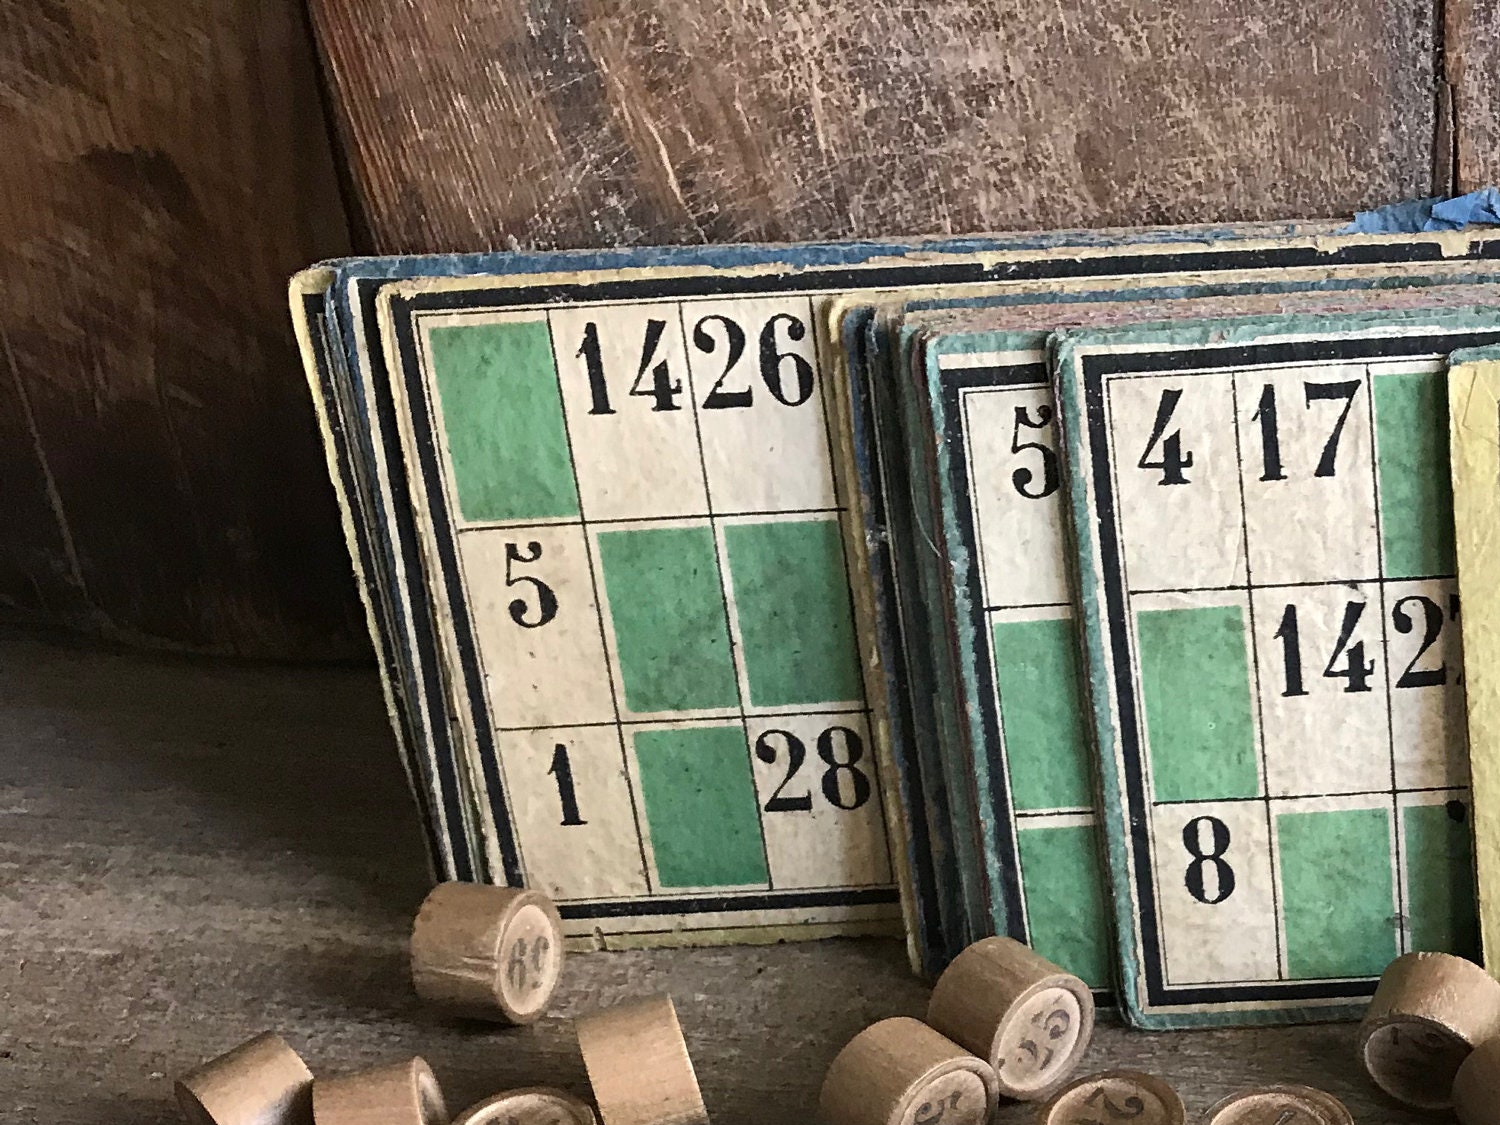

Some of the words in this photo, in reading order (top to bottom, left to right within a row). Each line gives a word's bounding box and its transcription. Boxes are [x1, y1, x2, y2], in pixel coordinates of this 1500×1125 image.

[575, 318, 682, 415] 14
[694, 314, 815, 409] 26
[1011, 404, 1058, 499] 5
[1138, 390, 1193, 486] 4
[1251, 381, 1361, 481] 17
[504, 541, 559, 628] 5
[1274, 601, 1374, 696] 14
[1392, 596, 1463, 689] 2
[547, 744, 588, 825] 1
[756, 727, 871, 812] 28
[1182, 816, 1235, 904] 8
